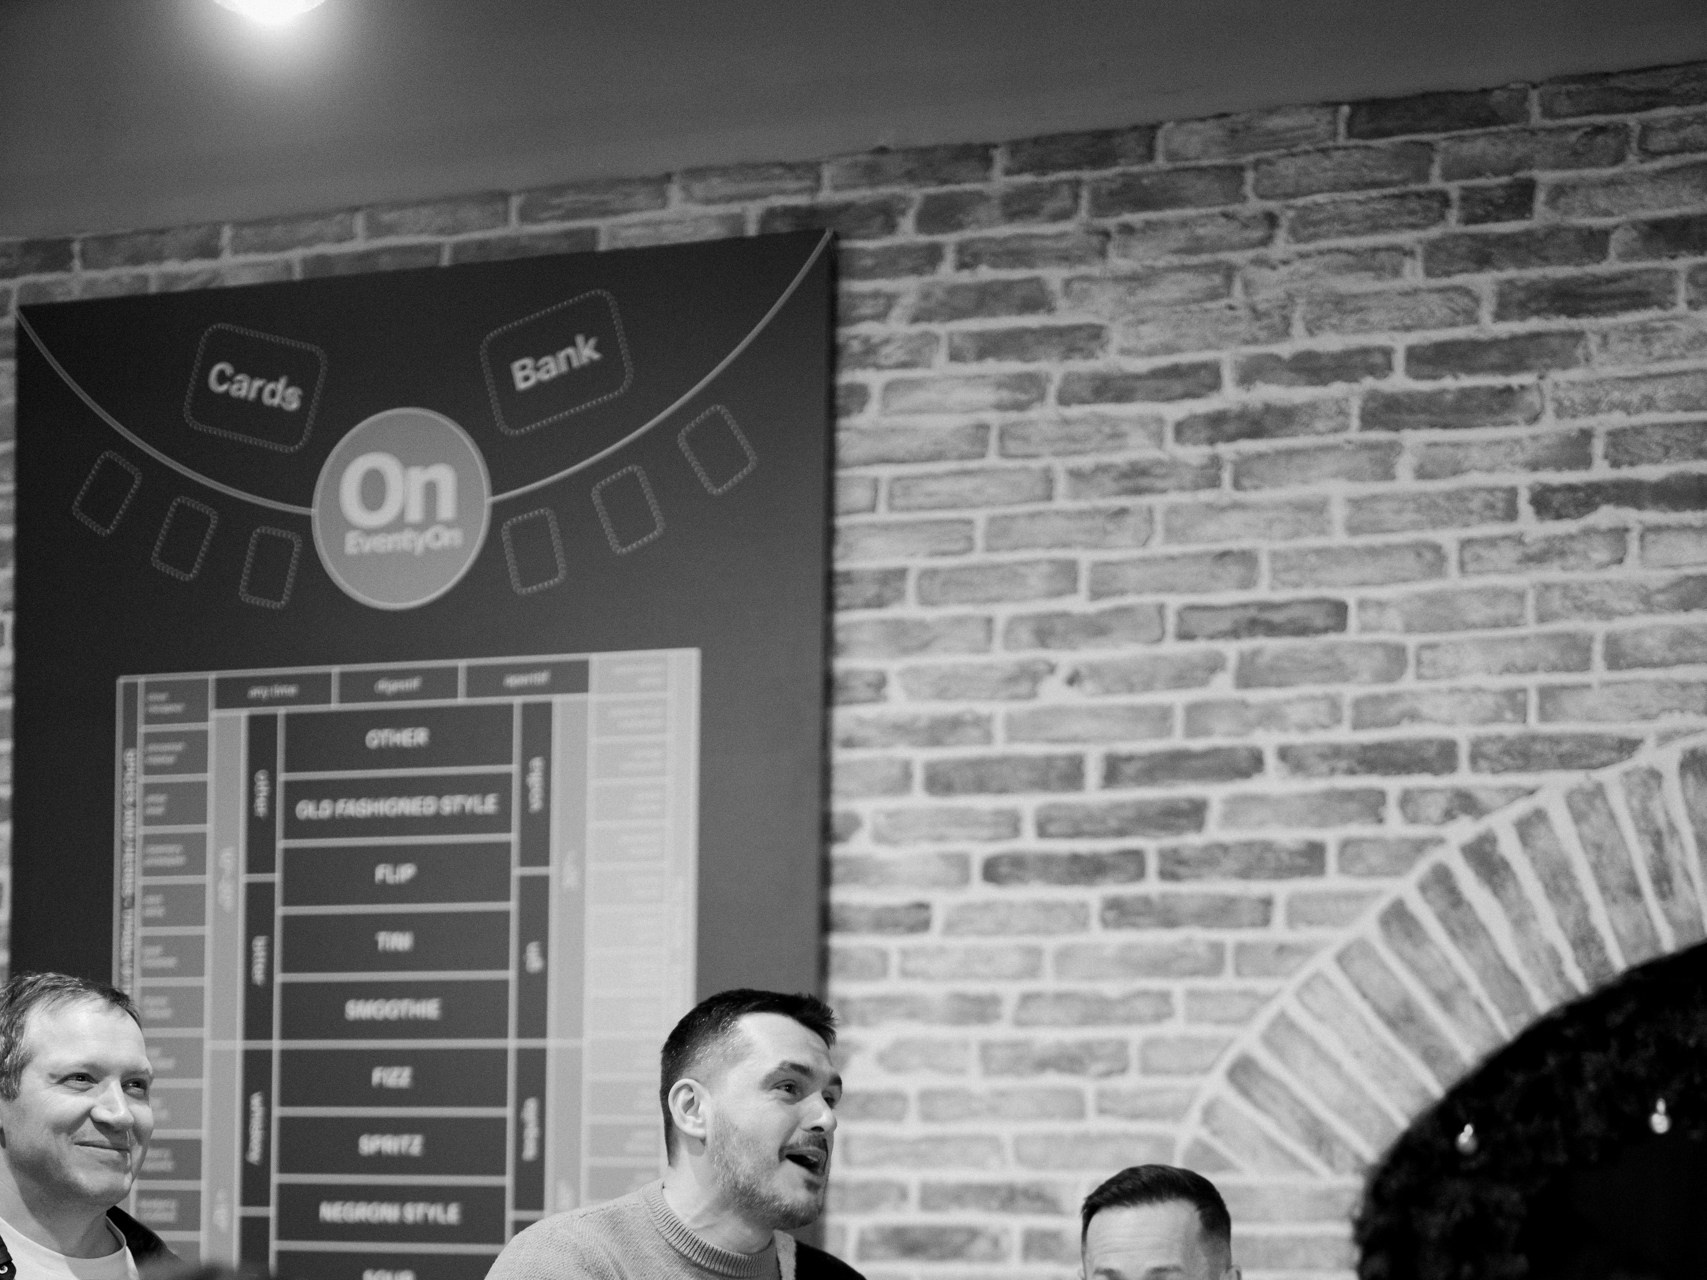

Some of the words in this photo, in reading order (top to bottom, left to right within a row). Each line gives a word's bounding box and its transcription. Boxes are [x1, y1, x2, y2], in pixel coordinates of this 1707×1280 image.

[510, 334, 602, 391] Bank
[208, 362, 303, 412] Cards
[341, 453, 458, 528] On
[365, 726, 430, 749] OTHER
[295, 799, 332, 820] OLD
[334, 796, 437, 819] FASHIONED
[438, 793, 499, 816] STYLE
[374, 862, 418, 885] FLIP
[344, 998, 441, 1021] SMOOTHIE
[371, 1066, 413, 1089] FIZZ
[358, 1133, 424, 1157] SPRITZ
[318, 1201, 400, 1224] NEGRONI
[402, 1202, 461, 1225] STYLE
